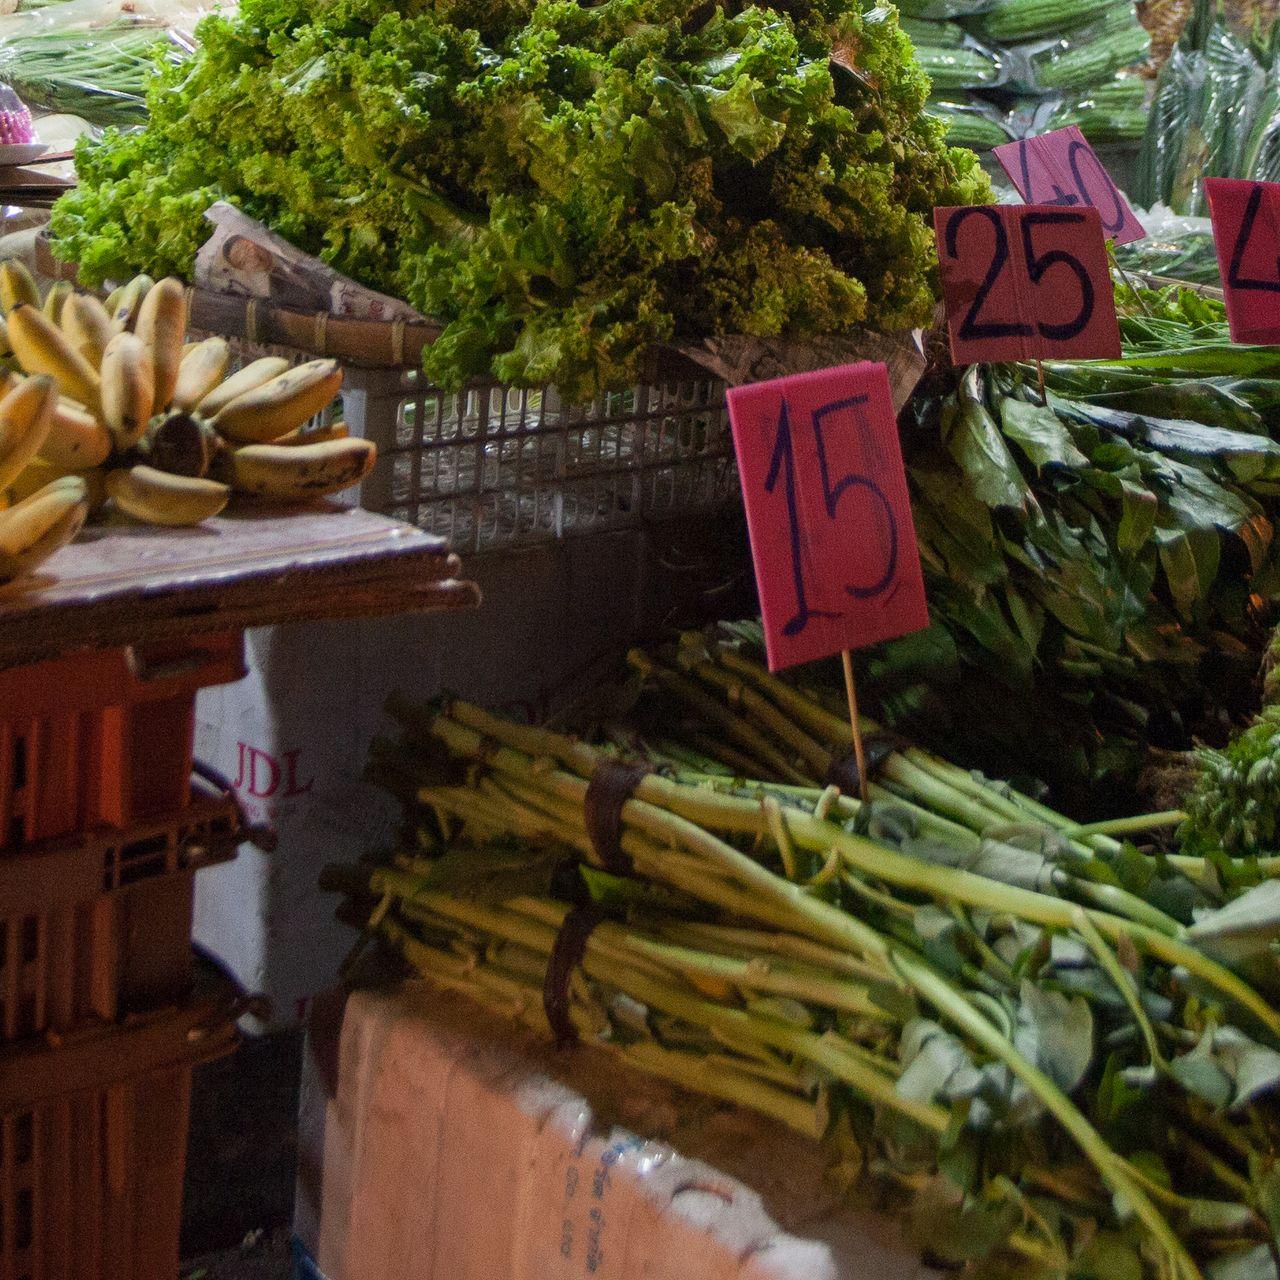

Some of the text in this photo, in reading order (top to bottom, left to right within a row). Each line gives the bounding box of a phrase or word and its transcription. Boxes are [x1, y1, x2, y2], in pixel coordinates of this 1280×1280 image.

[1022, 139, 1124, 233] 40
[944, 206, 1095, 341] 25
[764, 398, 898, 636] 15
[233, 740, 315, 798] JDL
